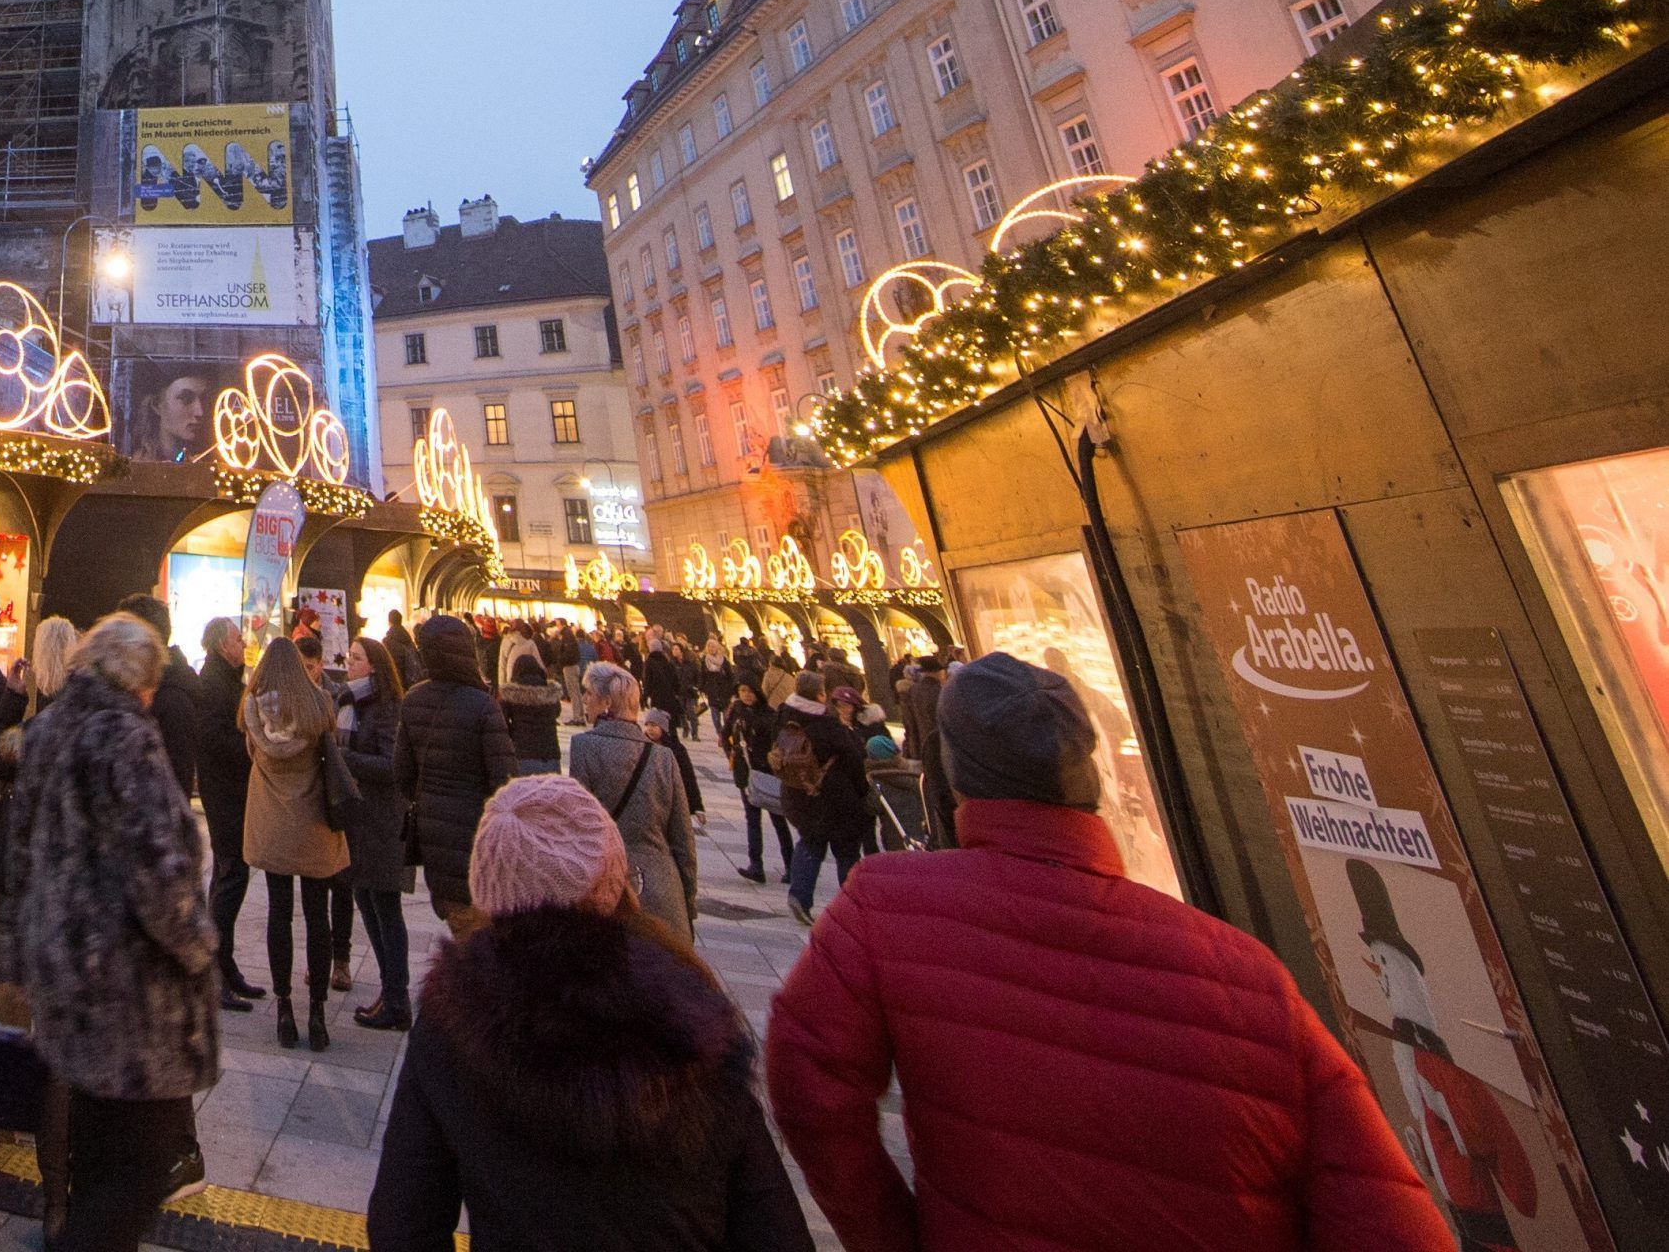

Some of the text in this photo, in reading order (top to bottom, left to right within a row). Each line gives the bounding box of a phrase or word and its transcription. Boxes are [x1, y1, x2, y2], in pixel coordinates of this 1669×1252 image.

[154, 130, 192, 138] Museum
[194, 126, 271, 138] Niederösterreich
[165, 120, 180, 128] der
[182, 118, 232, 128] Geschichte
[227, 283, 266, 294] UNSER
[156, 294, 269, 308] STEPHANSDOM
[256, 514, 278, 536] BIG
[255, 535, 277, 556] BUS
[1245, 575, 1306, 616] Radio
[1303, 752, 1372, 801] Frohe
[1289, 803, 1433, 860] Weihnachten
